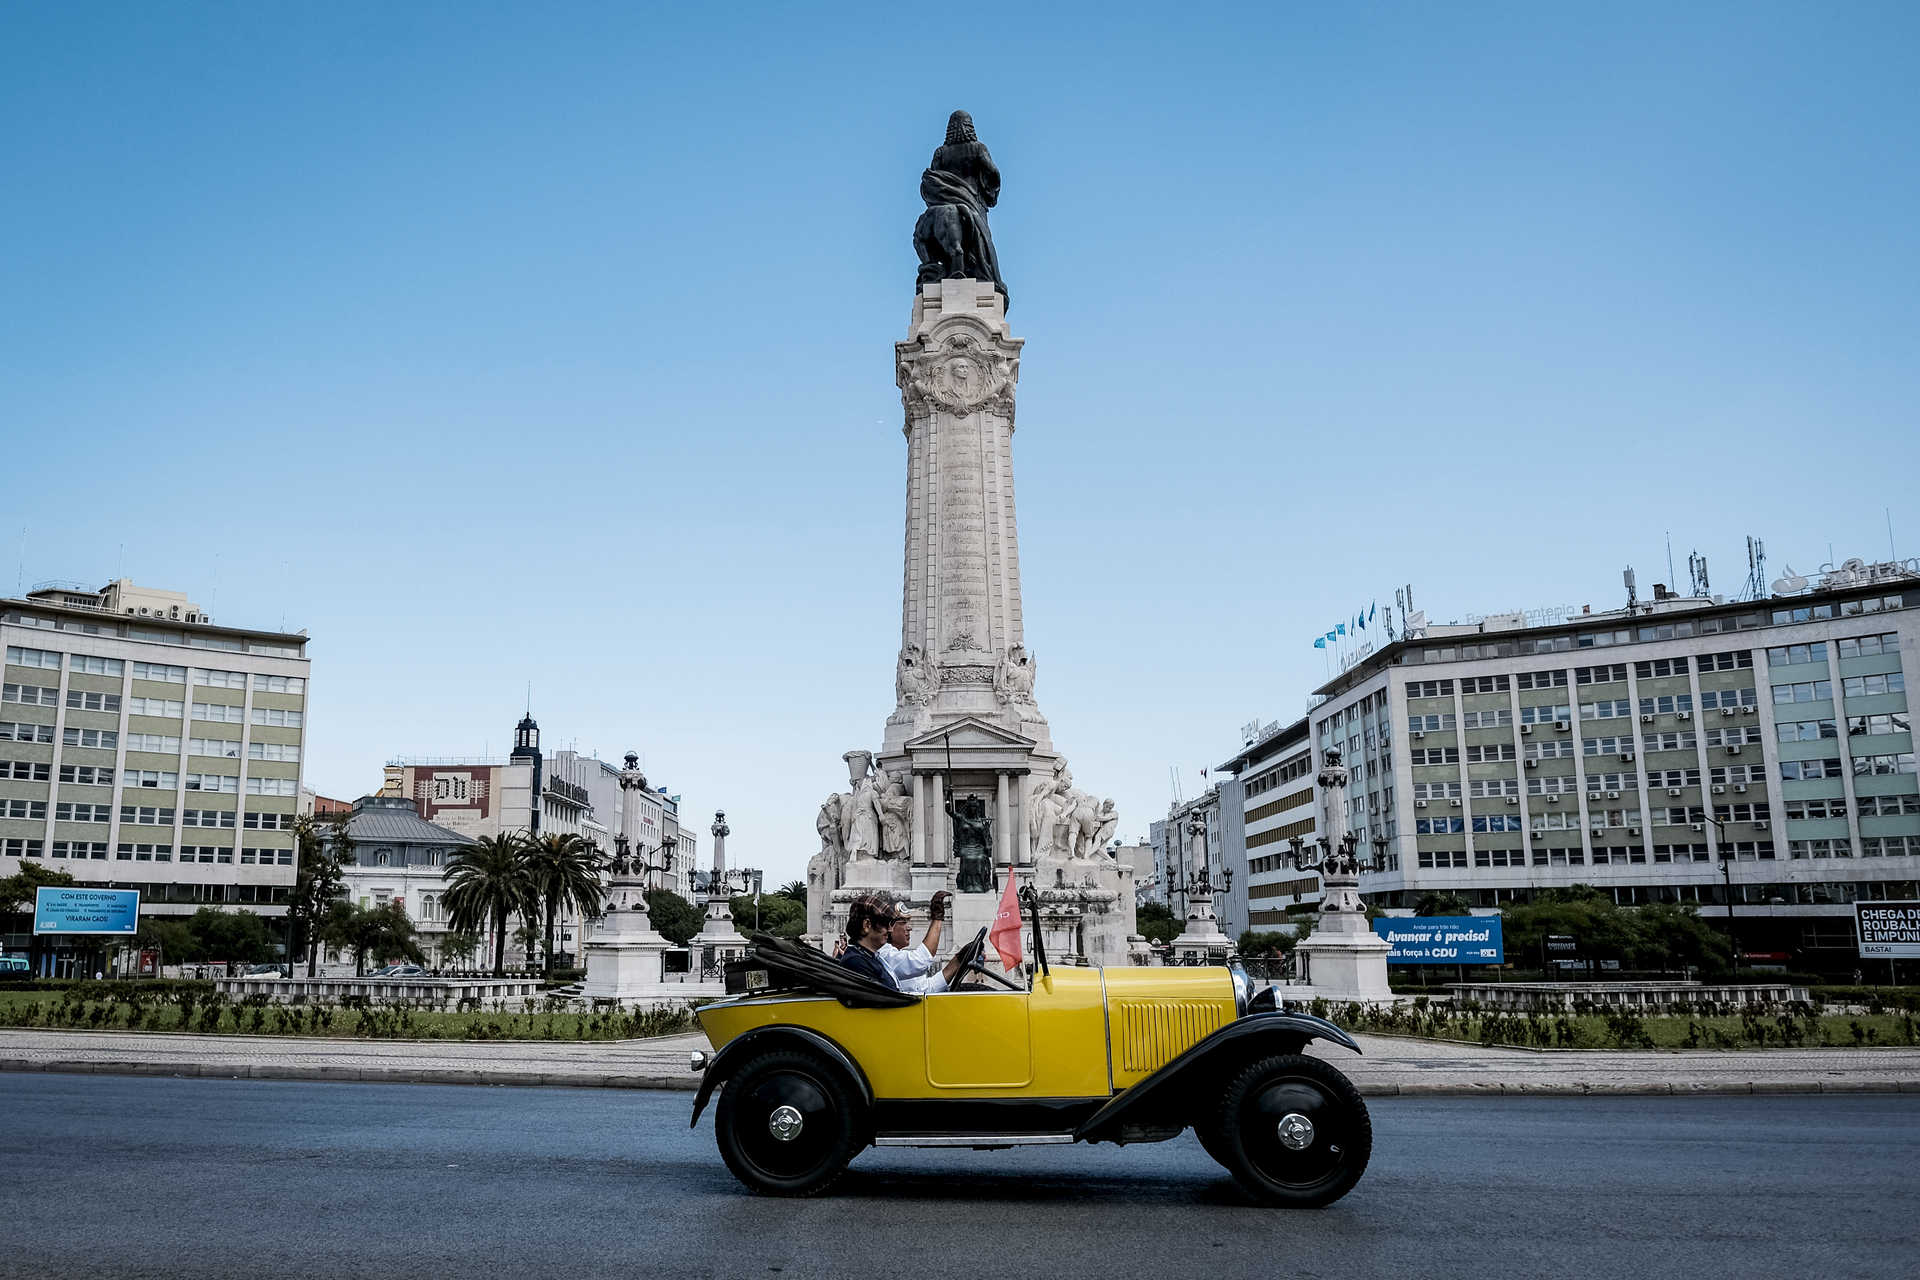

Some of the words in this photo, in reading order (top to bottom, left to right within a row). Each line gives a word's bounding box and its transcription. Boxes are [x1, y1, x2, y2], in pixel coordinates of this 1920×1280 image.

[1818, 558, 1920, 589] Santan
[1861, 909, 1906, 920] CHEGA
[1386, 930, 1432, 944] Avançar
[1434, 930, 1443, 942] é
[1444, 929, 1490, 945] preciso!
[1863, 931, 1873, 941] E
[1874, 931, 1920, 941] IMPUNI
[1402, 948, 1423, 959] força
[1431, 947, 1458, 958] CDU
